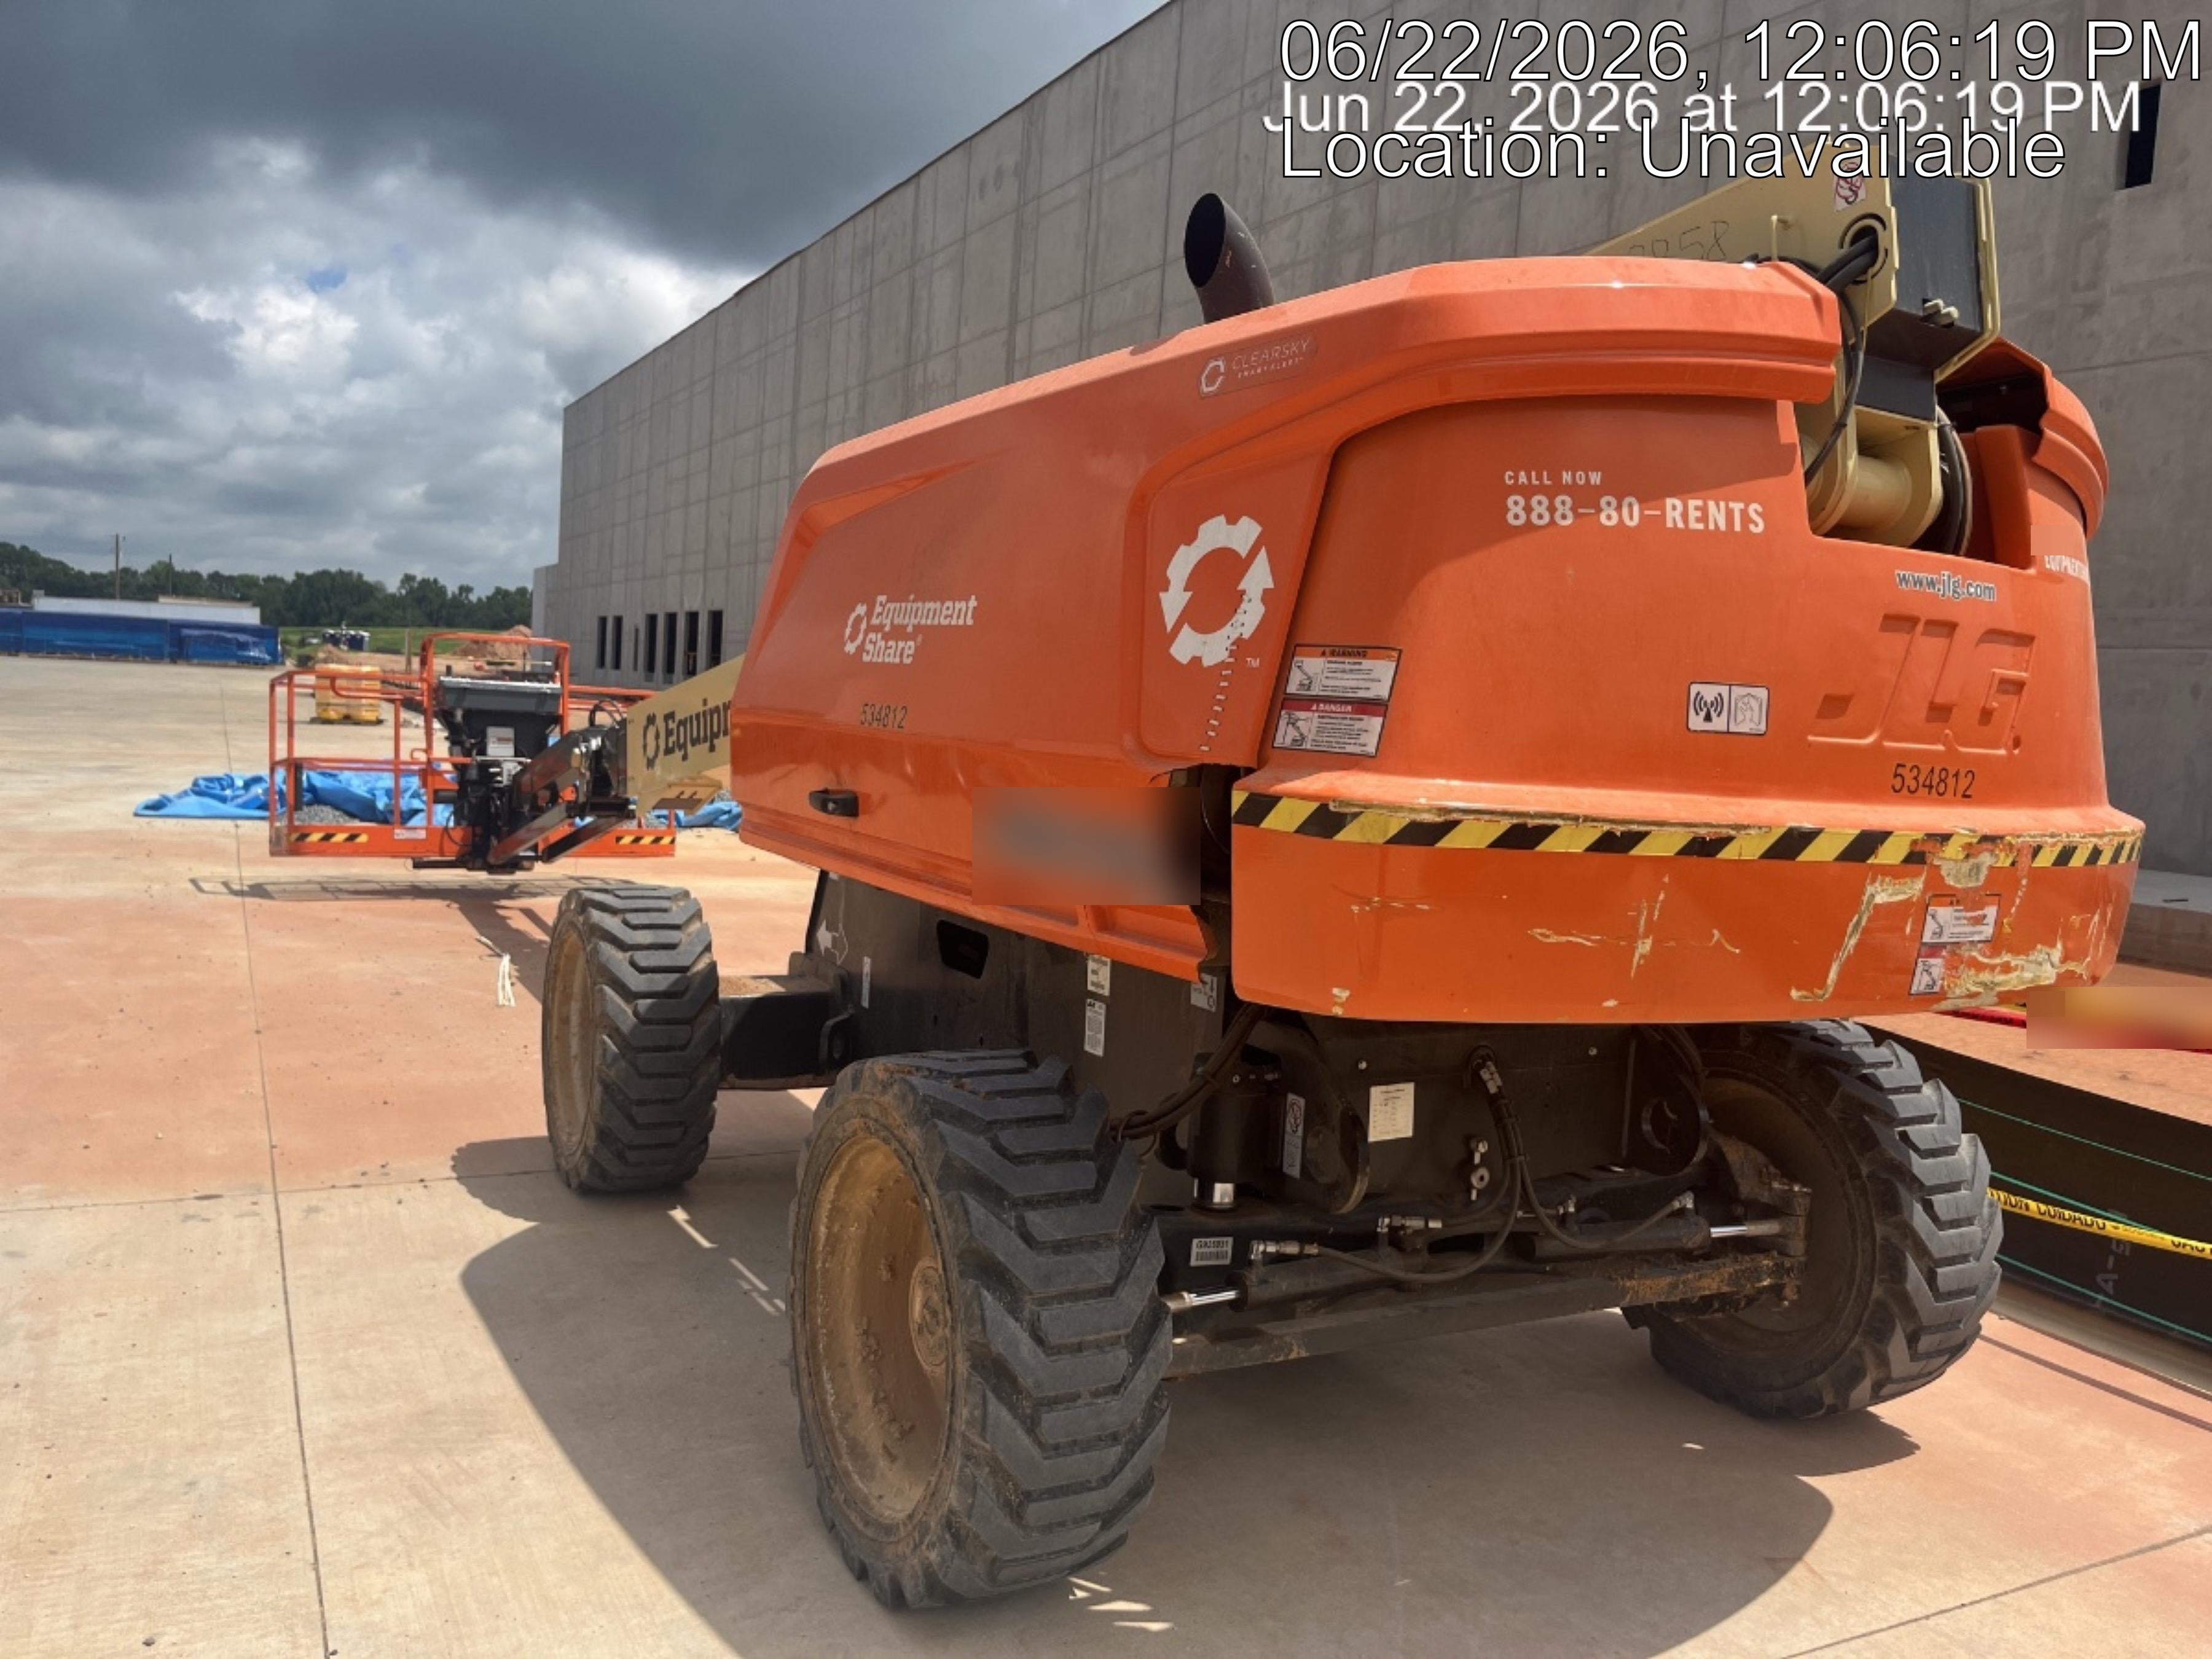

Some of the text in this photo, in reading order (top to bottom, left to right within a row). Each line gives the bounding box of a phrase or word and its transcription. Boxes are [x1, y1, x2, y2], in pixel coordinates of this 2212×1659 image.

[1232, 339, 1310, 369] CLEARSKY
[1505, 471, 1602, 485] CALL NOW
[1506, 495, 1765, 533] 888-80-RENTS
[1895, 570, 1996, 602] www.jlg.com
[871, 594, 978, 632] Equipment
[863, 632, 916, 664] Share
[1808, 613, 2035, 755] JLG
[860, 704, 908, 729] 534812
[1891, 763, 1976, 799] 534812
